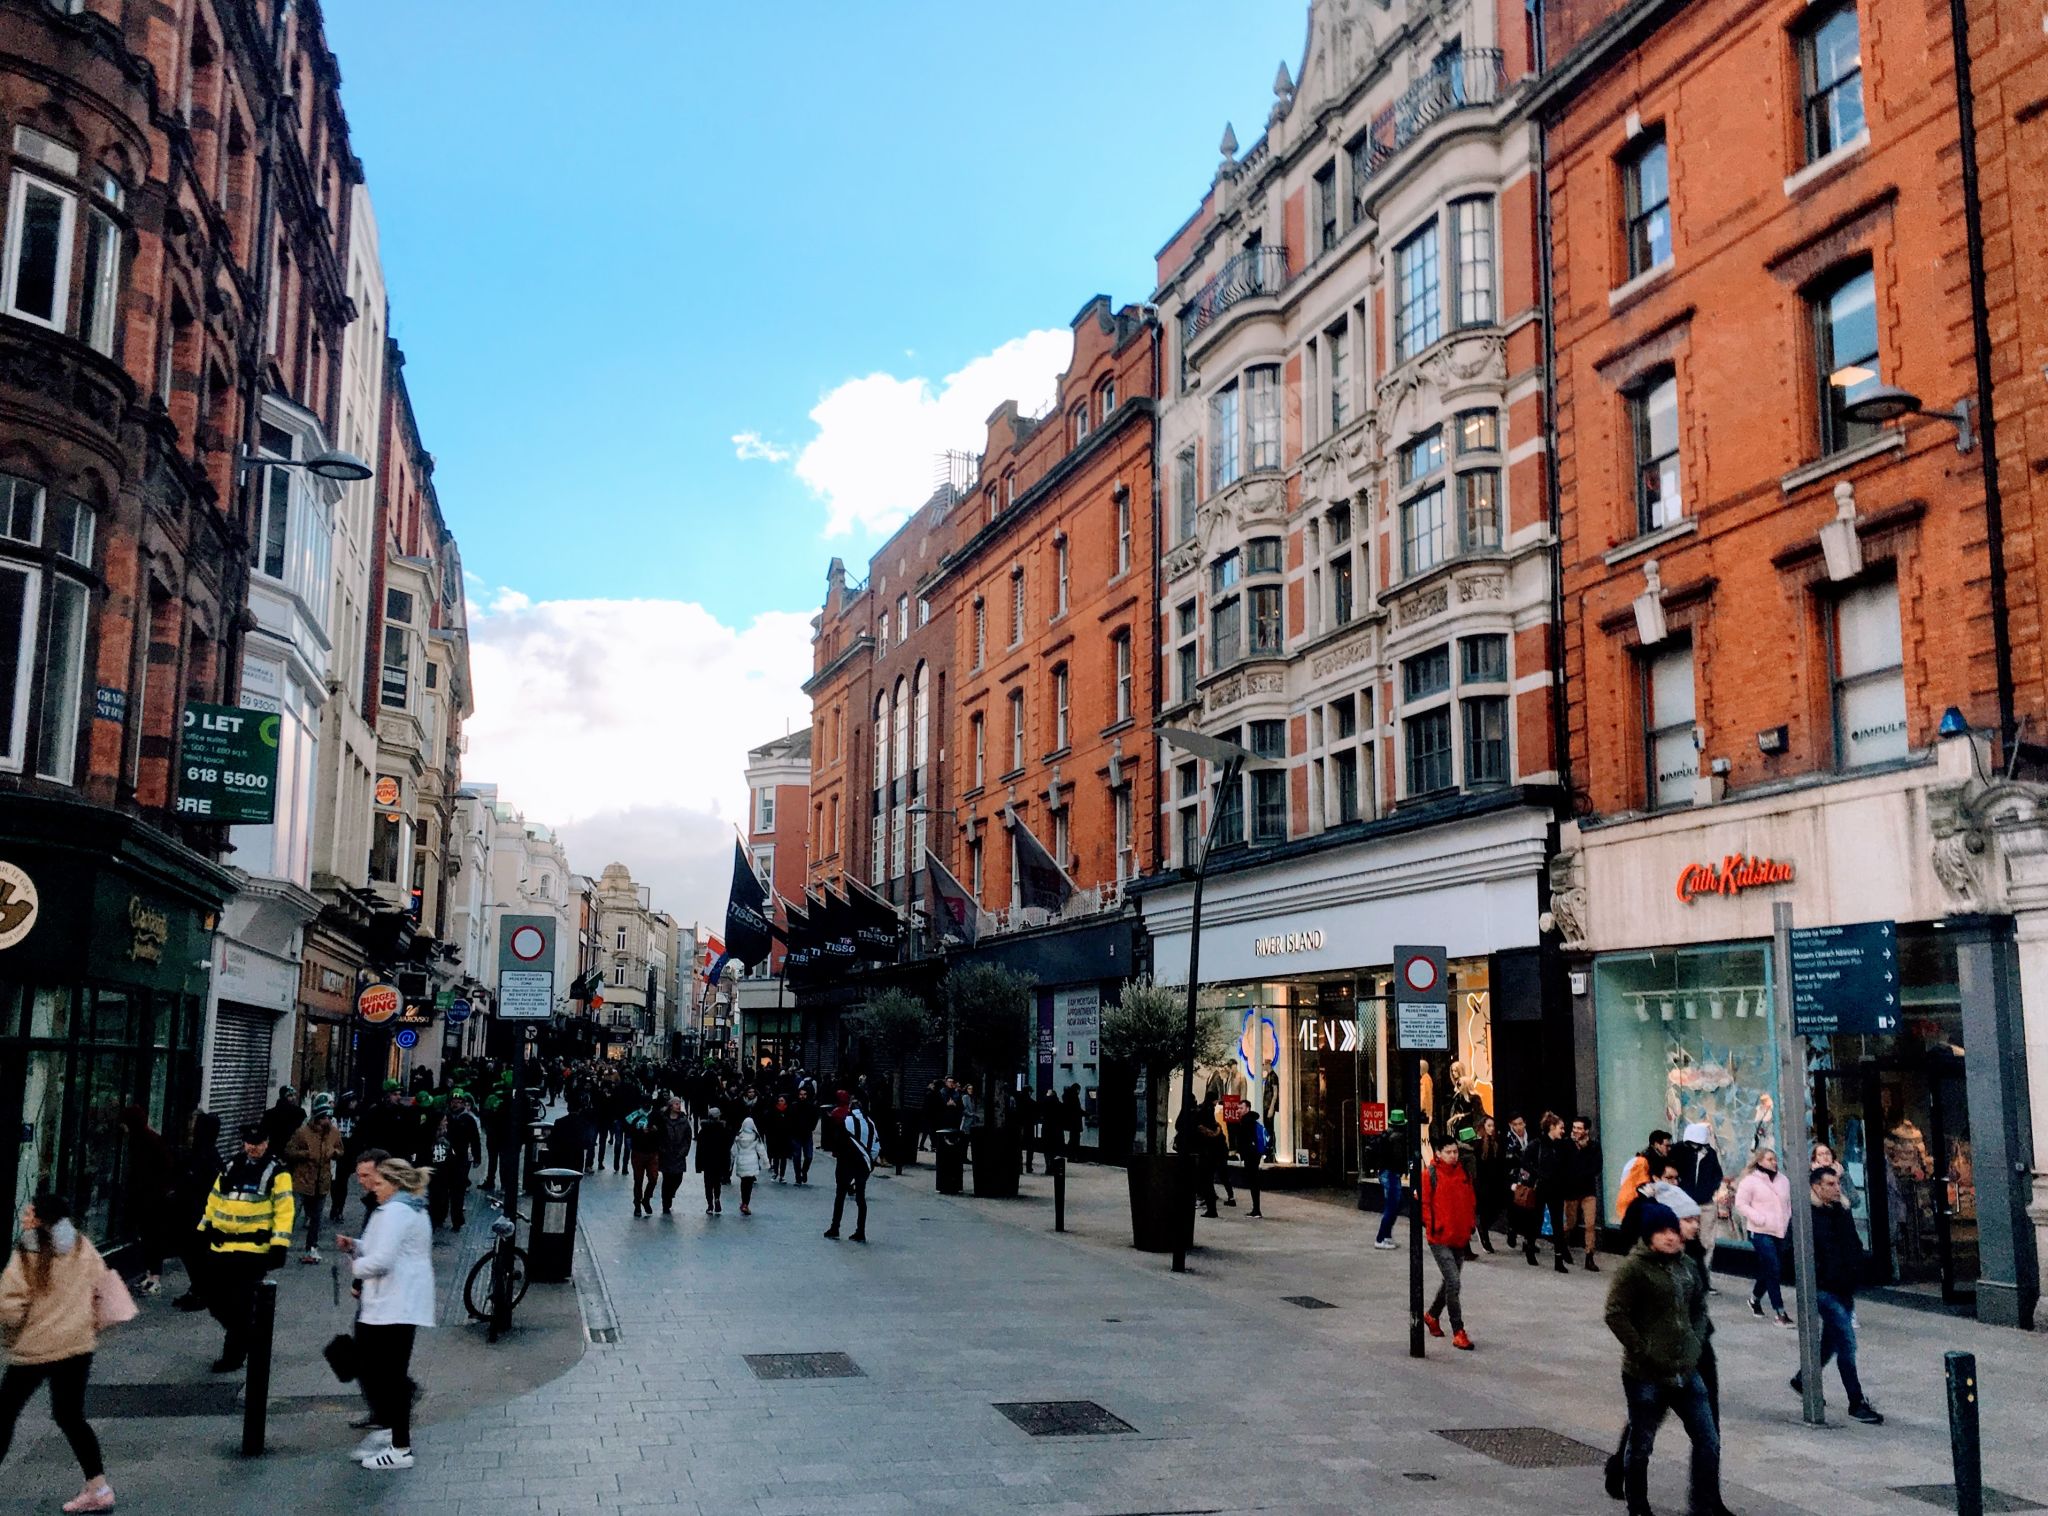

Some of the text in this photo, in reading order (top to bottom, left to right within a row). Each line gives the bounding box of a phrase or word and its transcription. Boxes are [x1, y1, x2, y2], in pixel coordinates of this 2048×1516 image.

[184, 711, 244, 733] O LET
[187, 766, 269, 788] 618 5500
[176, 796, 212, 814] BRE
[1676, 852, 1792, 904] Cath Kidston
[730, 900, 768, 932] TISSOT
[857, 929, 895, 944] TISSOT
[1255, 930, 1324, 956] RIVER ISLAND
[824, 941, 856, 953] TISSO
[360, 991, 397, 1007] BURGER
[361, 1000, 397, 1017] KING
[398, 1015, 430, 1023] WAROVSKI
[1224, 1109, 1240, 1120] SALE
[1363, 1110, 1383, 1118] 50% OFF
[1363, 1119, 1384, 1132] SALE
